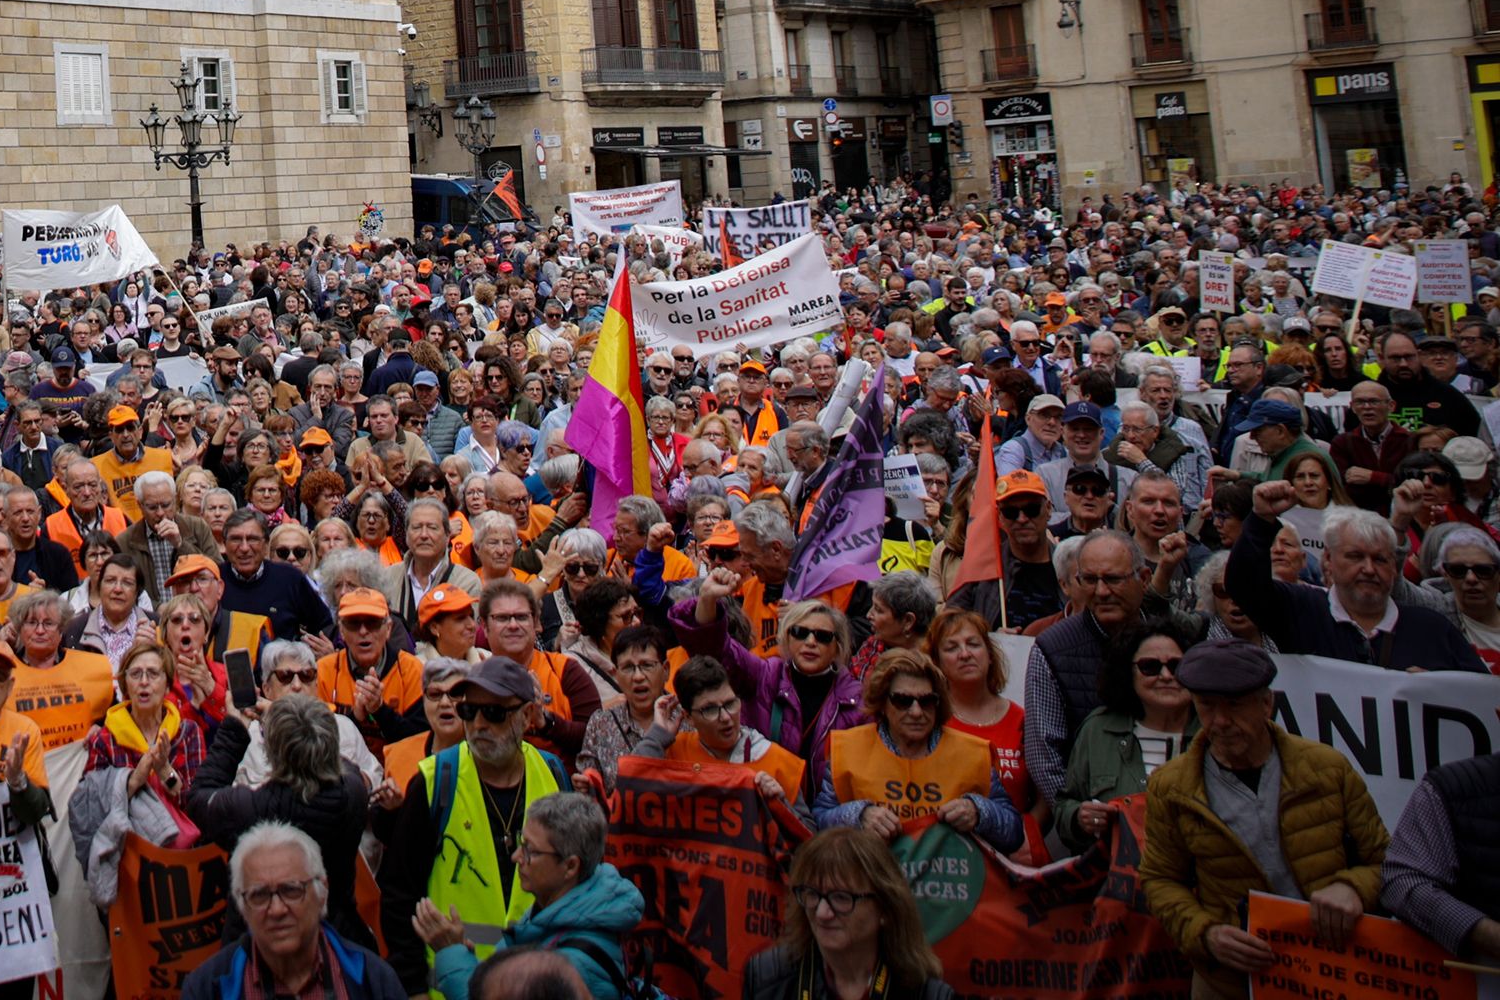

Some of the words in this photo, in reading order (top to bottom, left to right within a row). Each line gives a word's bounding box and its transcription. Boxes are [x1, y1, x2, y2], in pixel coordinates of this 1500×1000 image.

[1337, 71, 1390, 95] pans
[991, 96, 1044, 117] BARCELONA
[1157, 105, 1185, 120] pans
[707, 209, 736, 229] LA
[747, 203, 809, 229] SALUT
[651, 290, 684, 306] Per
[688, 285, 709, 300] la
[711, 256, 791, 293] Defensa
[1204, 281, 1229, 292] DRET
[668, 309, 693, 325] de
[697, 306, 716, 322] la
[719, 280, 790, 316] Sanitat
[787, 294, 834, 316] MAREA
[696, 315, 773, 344] Pública
[884, 780, 943, 803] SOS
[715, 853, 738, 871] ES
[2, 880, 30, 900] BOI
[1318, 962, 1348, 982] DE
[1354, 944, 1453, 981] PÚBLICS
